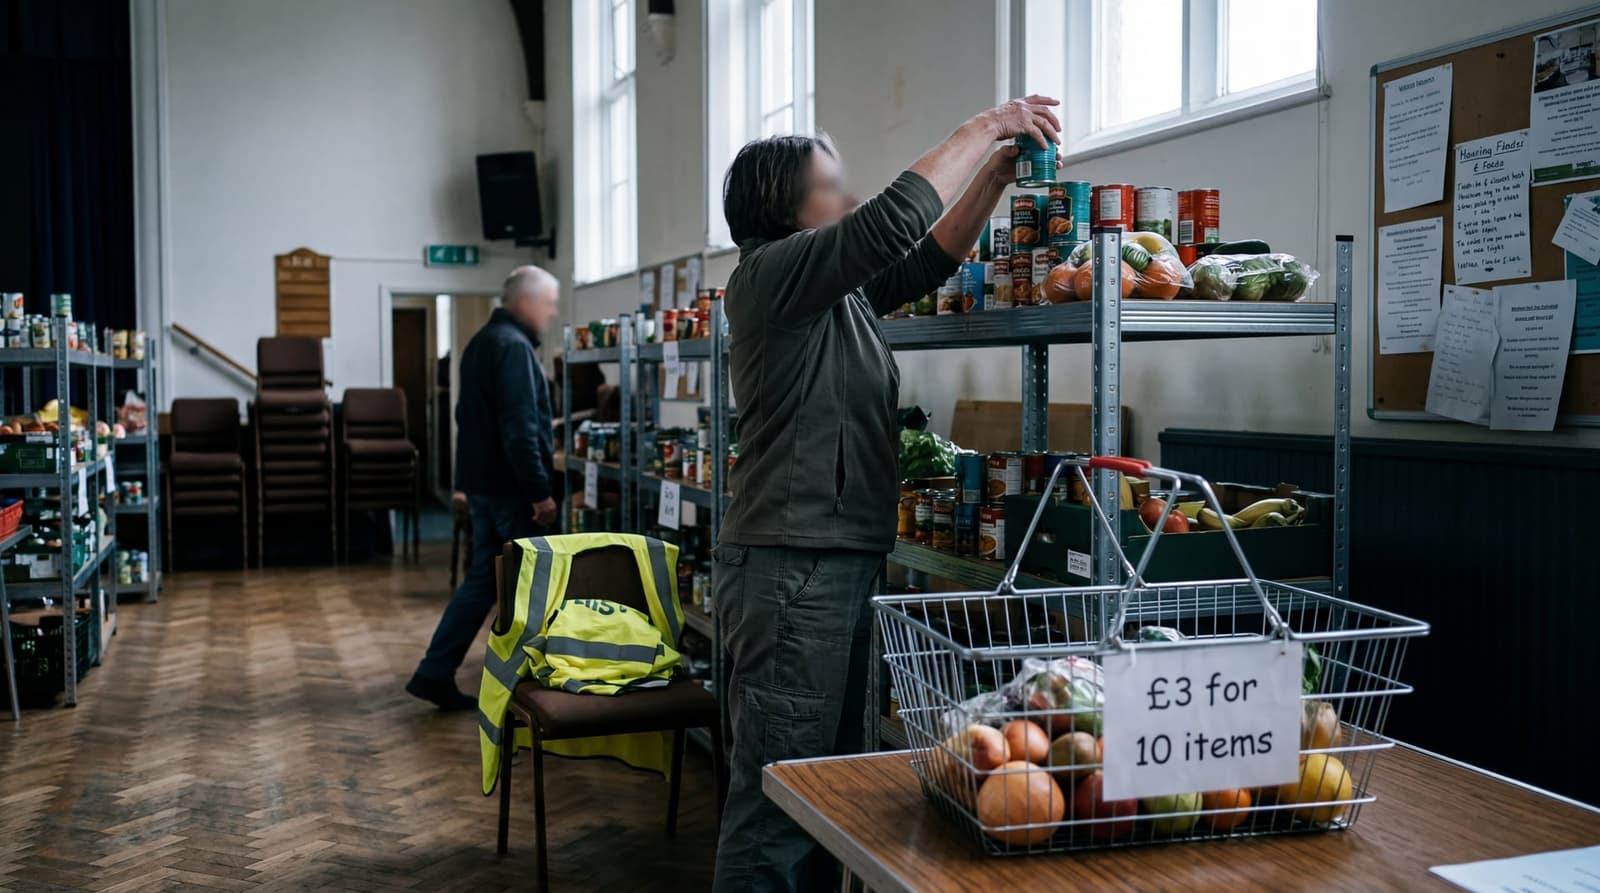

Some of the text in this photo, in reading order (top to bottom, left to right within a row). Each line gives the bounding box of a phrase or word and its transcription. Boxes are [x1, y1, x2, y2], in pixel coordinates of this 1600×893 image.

[1146, 672, 1258, 711] £3 for
[1136, 730, 1273, 767] 10 items
